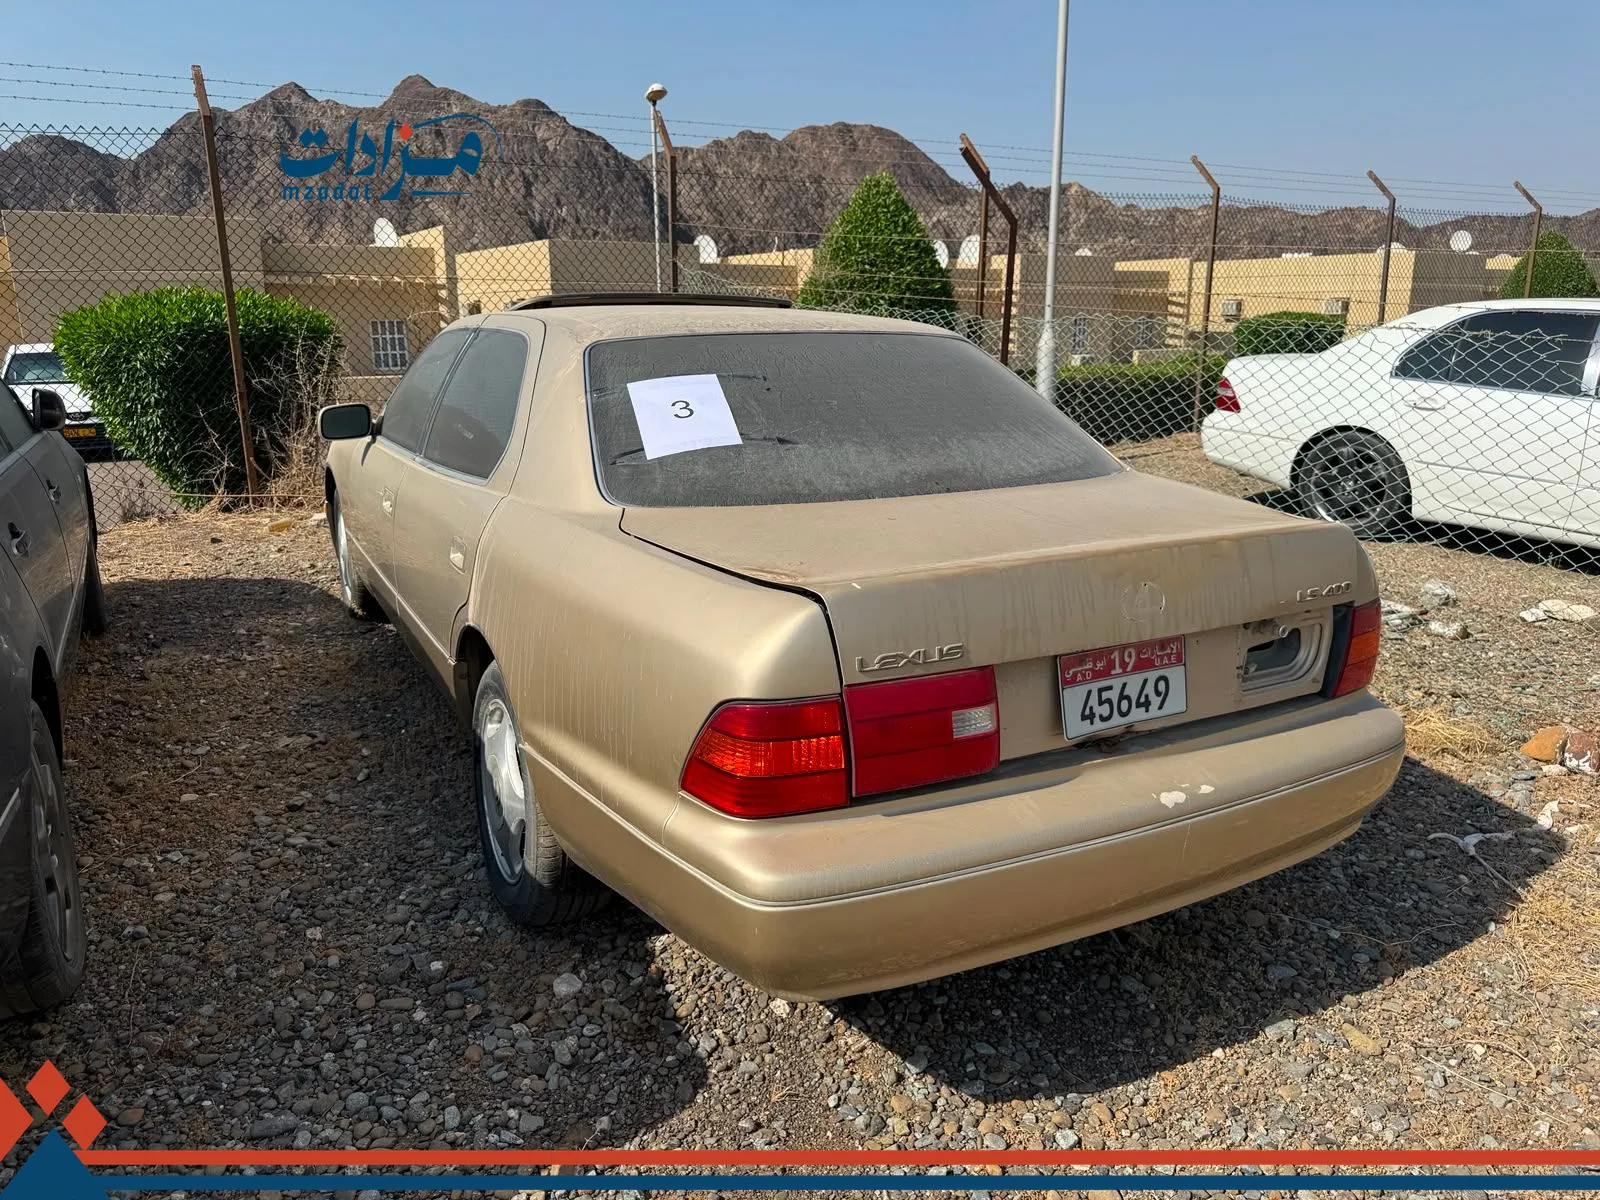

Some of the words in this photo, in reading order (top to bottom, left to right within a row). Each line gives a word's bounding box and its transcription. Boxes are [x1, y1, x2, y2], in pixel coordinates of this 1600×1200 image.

[670, 399, 695, 419] 3
[1296, 587, 1319, 603] LS
[855, 642, 963, 673] LEXUS
[1109, 646, 1136, 676] 19
[1080, 674, 1170, 726] 45649
